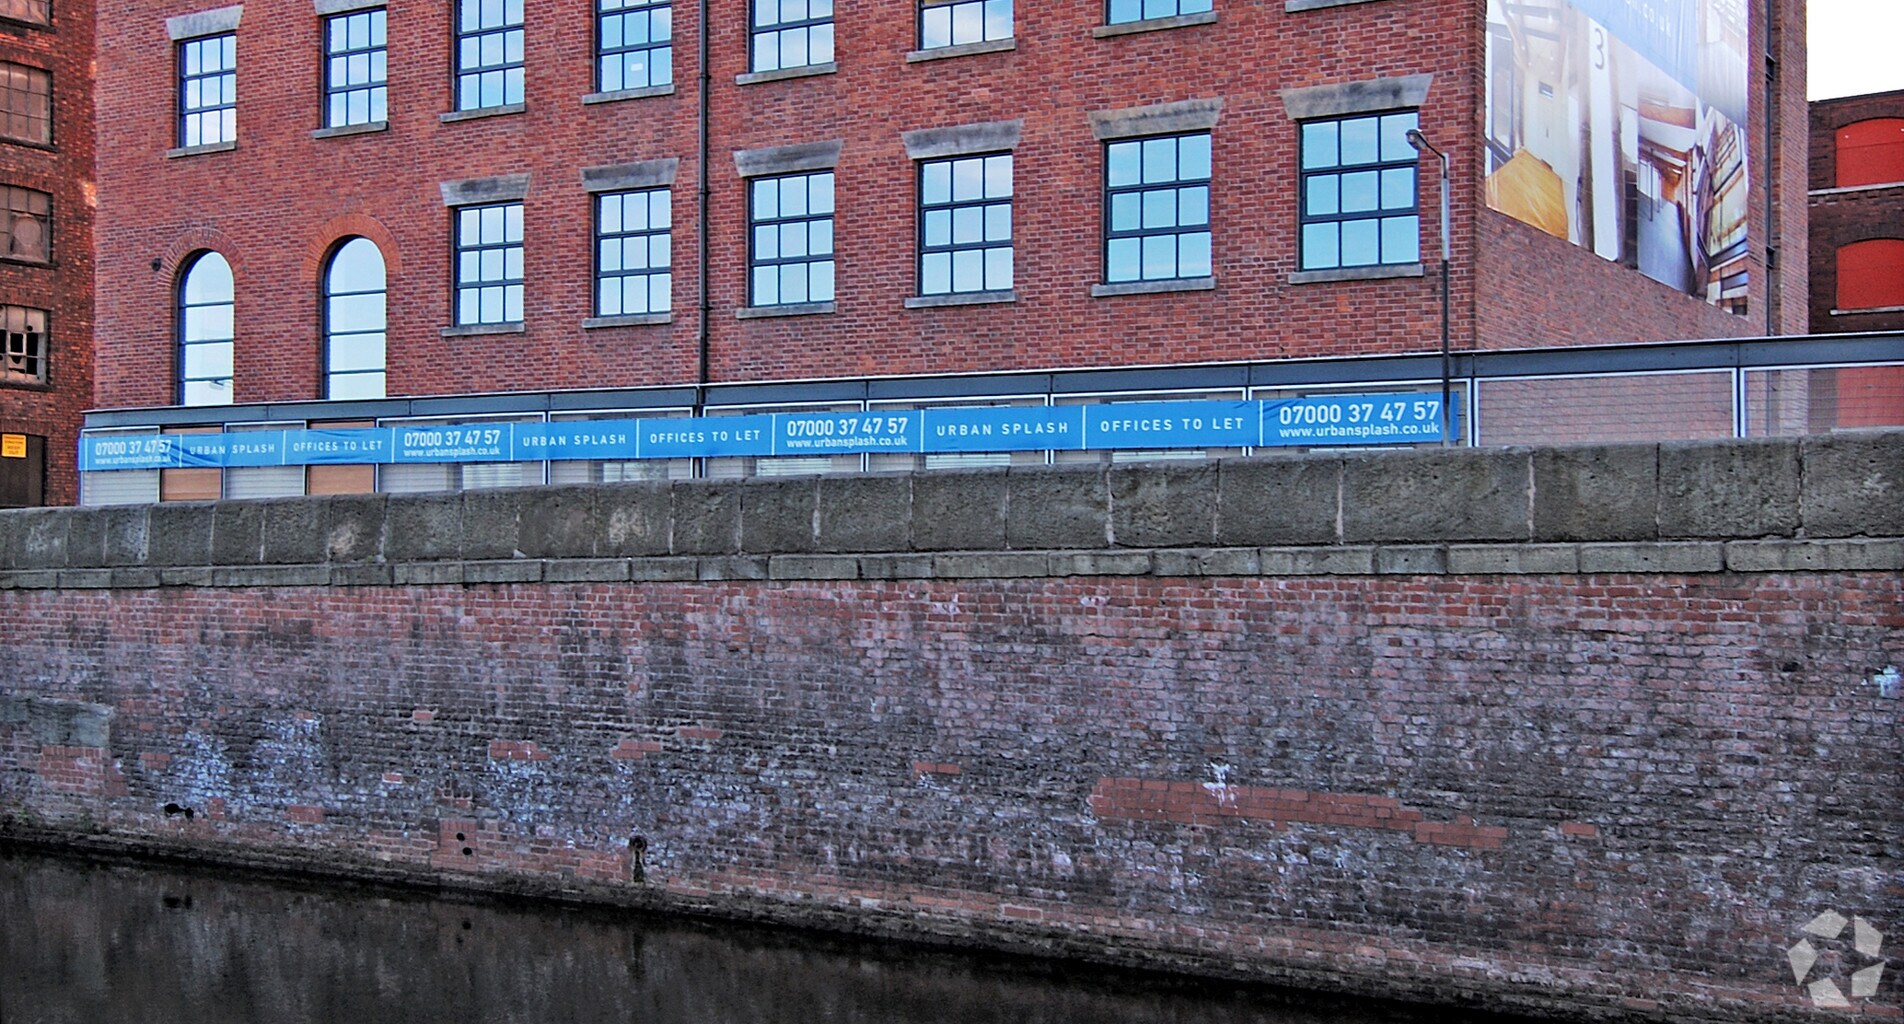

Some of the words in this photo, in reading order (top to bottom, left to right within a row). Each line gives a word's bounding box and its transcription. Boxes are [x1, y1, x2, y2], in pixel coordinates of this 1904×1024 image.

[1279, 404, 1341, 425] 07000
[1348, 403, 1373, 423] 37
[1380, 402, 1405, 422] 47
[1413, 401, 1439, 421] 57
[787, 419, 834, 437] 07000
[838, 418, 858, 436] 37
[862, 417, 882, 435] 47
[887, 417, 908, 434] 57
[937, 424, 992, 437] URBAN
[1002, 422, 1068, 436] SPLASH
[1100, 419, 1172, 432] OFFICES
[1182, 418, 1202, 431] TO
[1213, 417, 1244, 430] LET
[1279, 422, 1439, 439] www.urbansplash.co.uk
[404, 432, 442, 447] 07000
[445, 431, 463, 446] 37
[464, 430, 482, 445] 47
[484, 429, 501, 445] 57
[522, 435, 567, 447] URBAN
[574, 433, 627, 446] SPLASH
[650, 431, 704, 444] OFFICES
[712, 430, 729, 442] TO
[735, 429, 760, 441] LET
[787, 436, 908, 449] www.urbansplash.co.uk
[95, 442, 126, 456] 07000
[128, 440, 141, 454] 37
[144, 440, 157, 453] 47
[158, 439, 172, 453] 57
[190, 446, 226, 456] URBAN
[232, 443, 275, 454] SPLASH
[293, 441, 338, 452] OFFICES
[344, 440, 358, 451] TO
[362, 439, 382, 451] LET
[403, 446, 501, 458] www.urbansplash.co.uk
